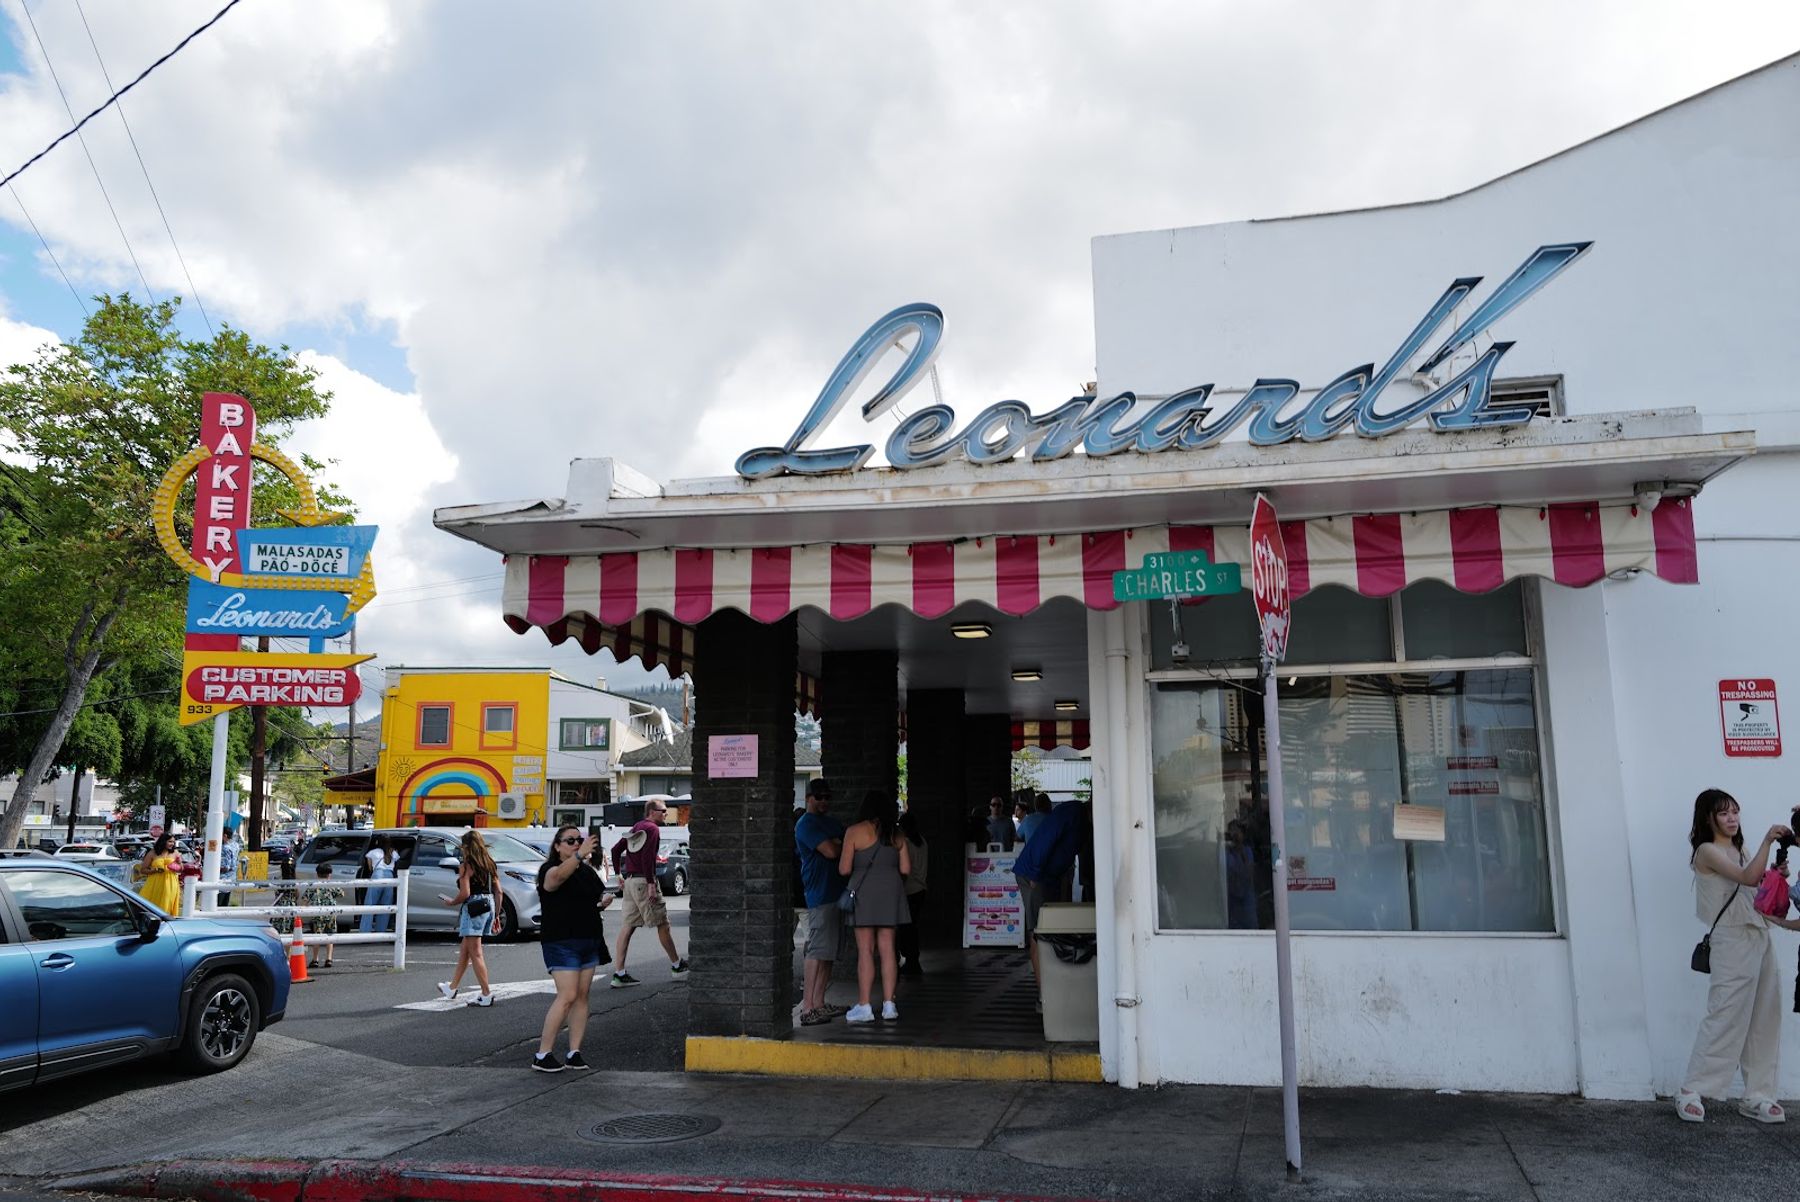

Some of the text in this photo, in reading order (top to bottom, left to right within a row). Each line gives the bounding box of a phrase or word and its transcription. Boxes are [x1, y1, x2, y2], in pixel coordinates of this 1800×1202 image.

[735, 241, 1595, 481] Leonard's
[202, 402, 245, 584] BAKERY
[257, 545, 343, 560] MALASADAS
[1125, 569, 1207, 596] CHARLES
[1254, 540, 1287, 610] STOP
[197, 592, 341, 629] Leonard's
[201, 667, 346, 685] CUSTOMER
[1737, 681, 1756, 690] NO
[204, 684, 344, 703] PARKING
[1721, 691, 1775, 699] TRESPASSING
[187, 705, 213, 714] 933
